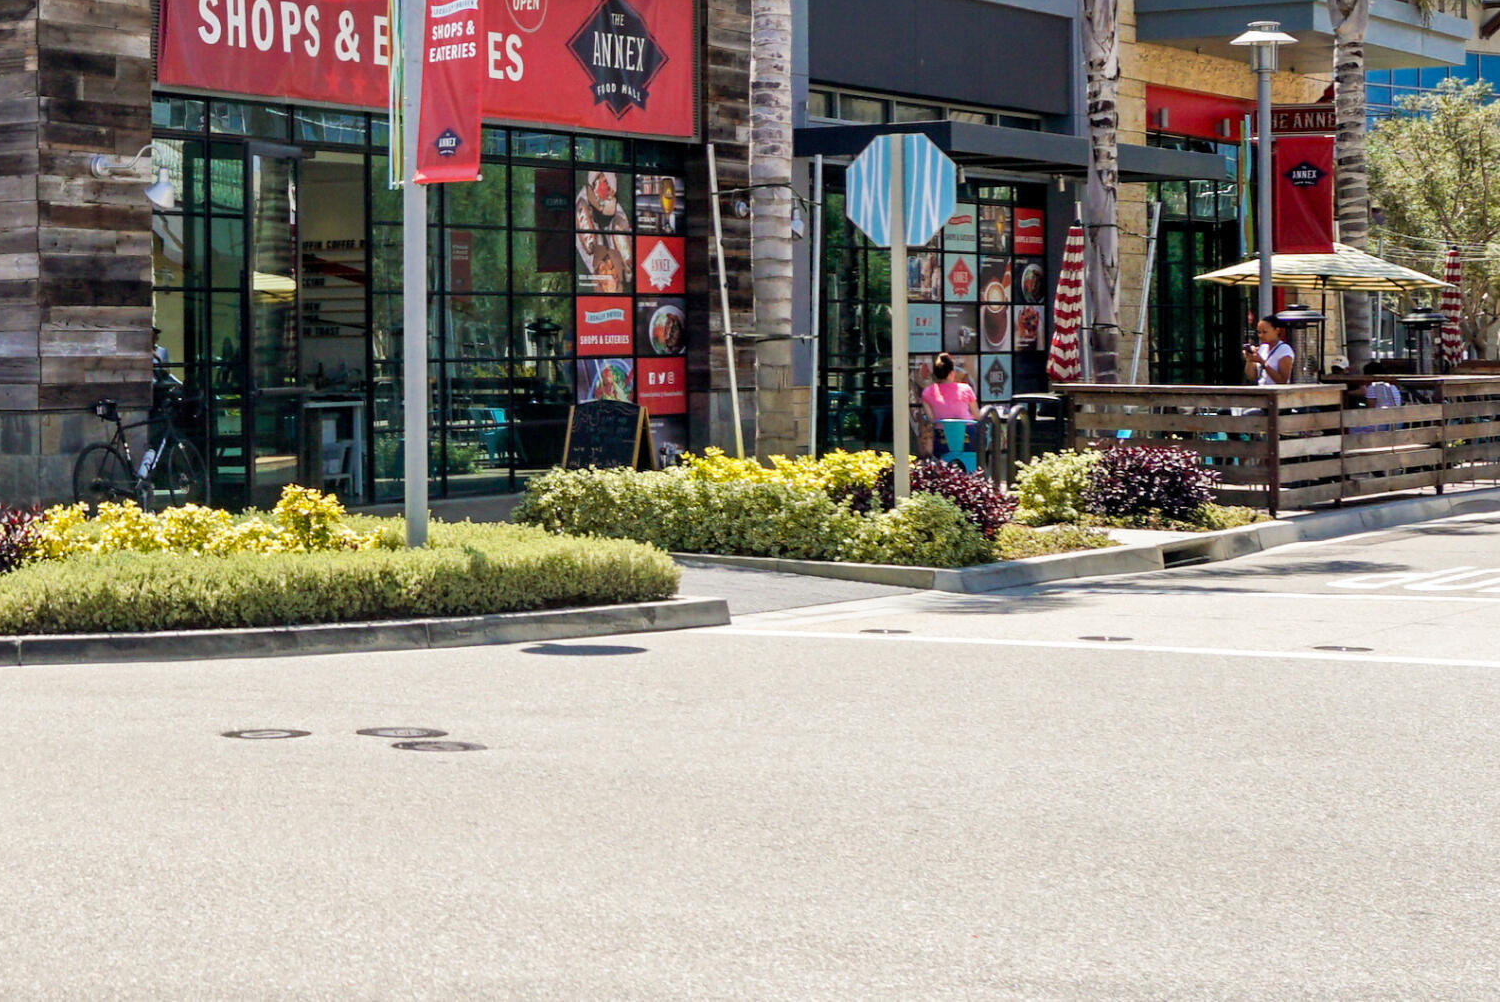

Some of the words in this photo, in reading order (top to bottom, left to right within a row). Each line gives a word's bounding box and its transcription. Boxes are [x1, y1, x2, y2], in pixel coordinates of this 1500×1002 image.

[611, 13, 625, 26] THE
[334, 10, 361, 63] &
[432, 22, 463, 40] SHOPS
[465, 20, 476, 35] &
[429, 42, 477, 63] EATERIES
[592, 31, 645, 72] ANNEX
[597, 83, 617, 96] FOOD
[621, 84, 642, 102] HALL
[1293, 112, 1337, 129] ANNE
[1292, 170, 1317, 179] ANNEX
